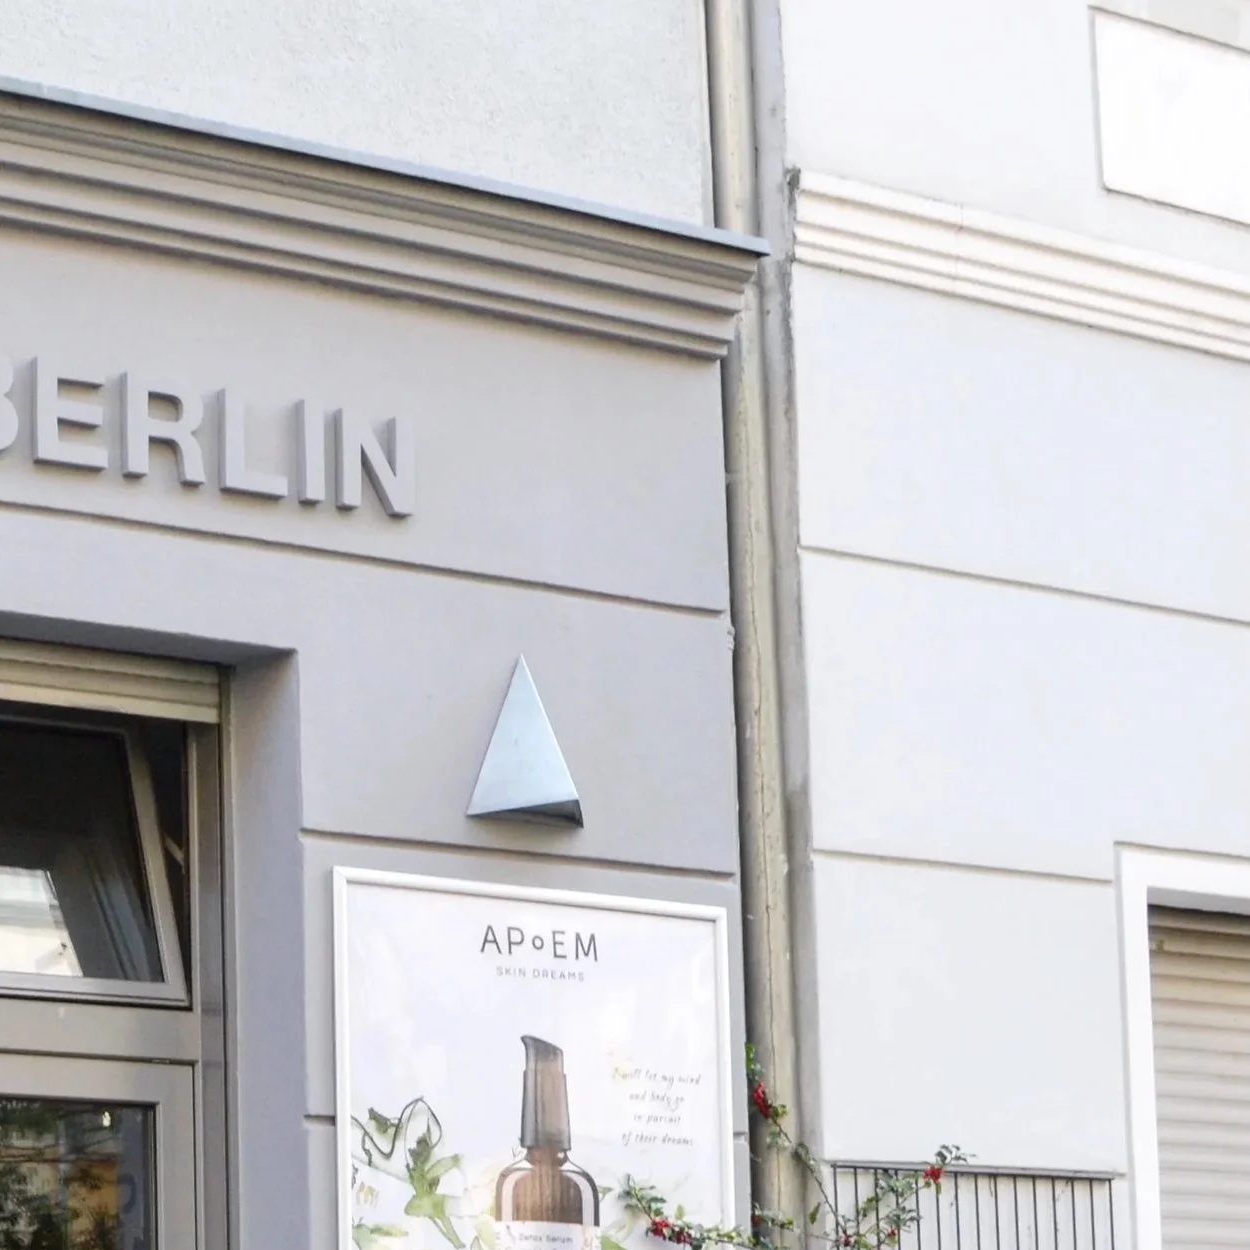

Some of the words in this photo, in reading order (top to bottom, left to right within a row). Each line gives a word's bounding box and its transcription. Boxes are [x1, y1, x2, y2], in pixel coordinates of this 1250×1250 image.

[496, 965, 527, 978] SKIN
[532, 967, 585, 982] DREAMS
[661, 1074, 675, 1090] my
[629, 1089, 647, 1101] and
[651, 1089, 671, 1109] body
[621, 1130, 632, 1147] of
[634, 1131, 658, 1143] their
[661, 1133, 694, 1147] dreams
